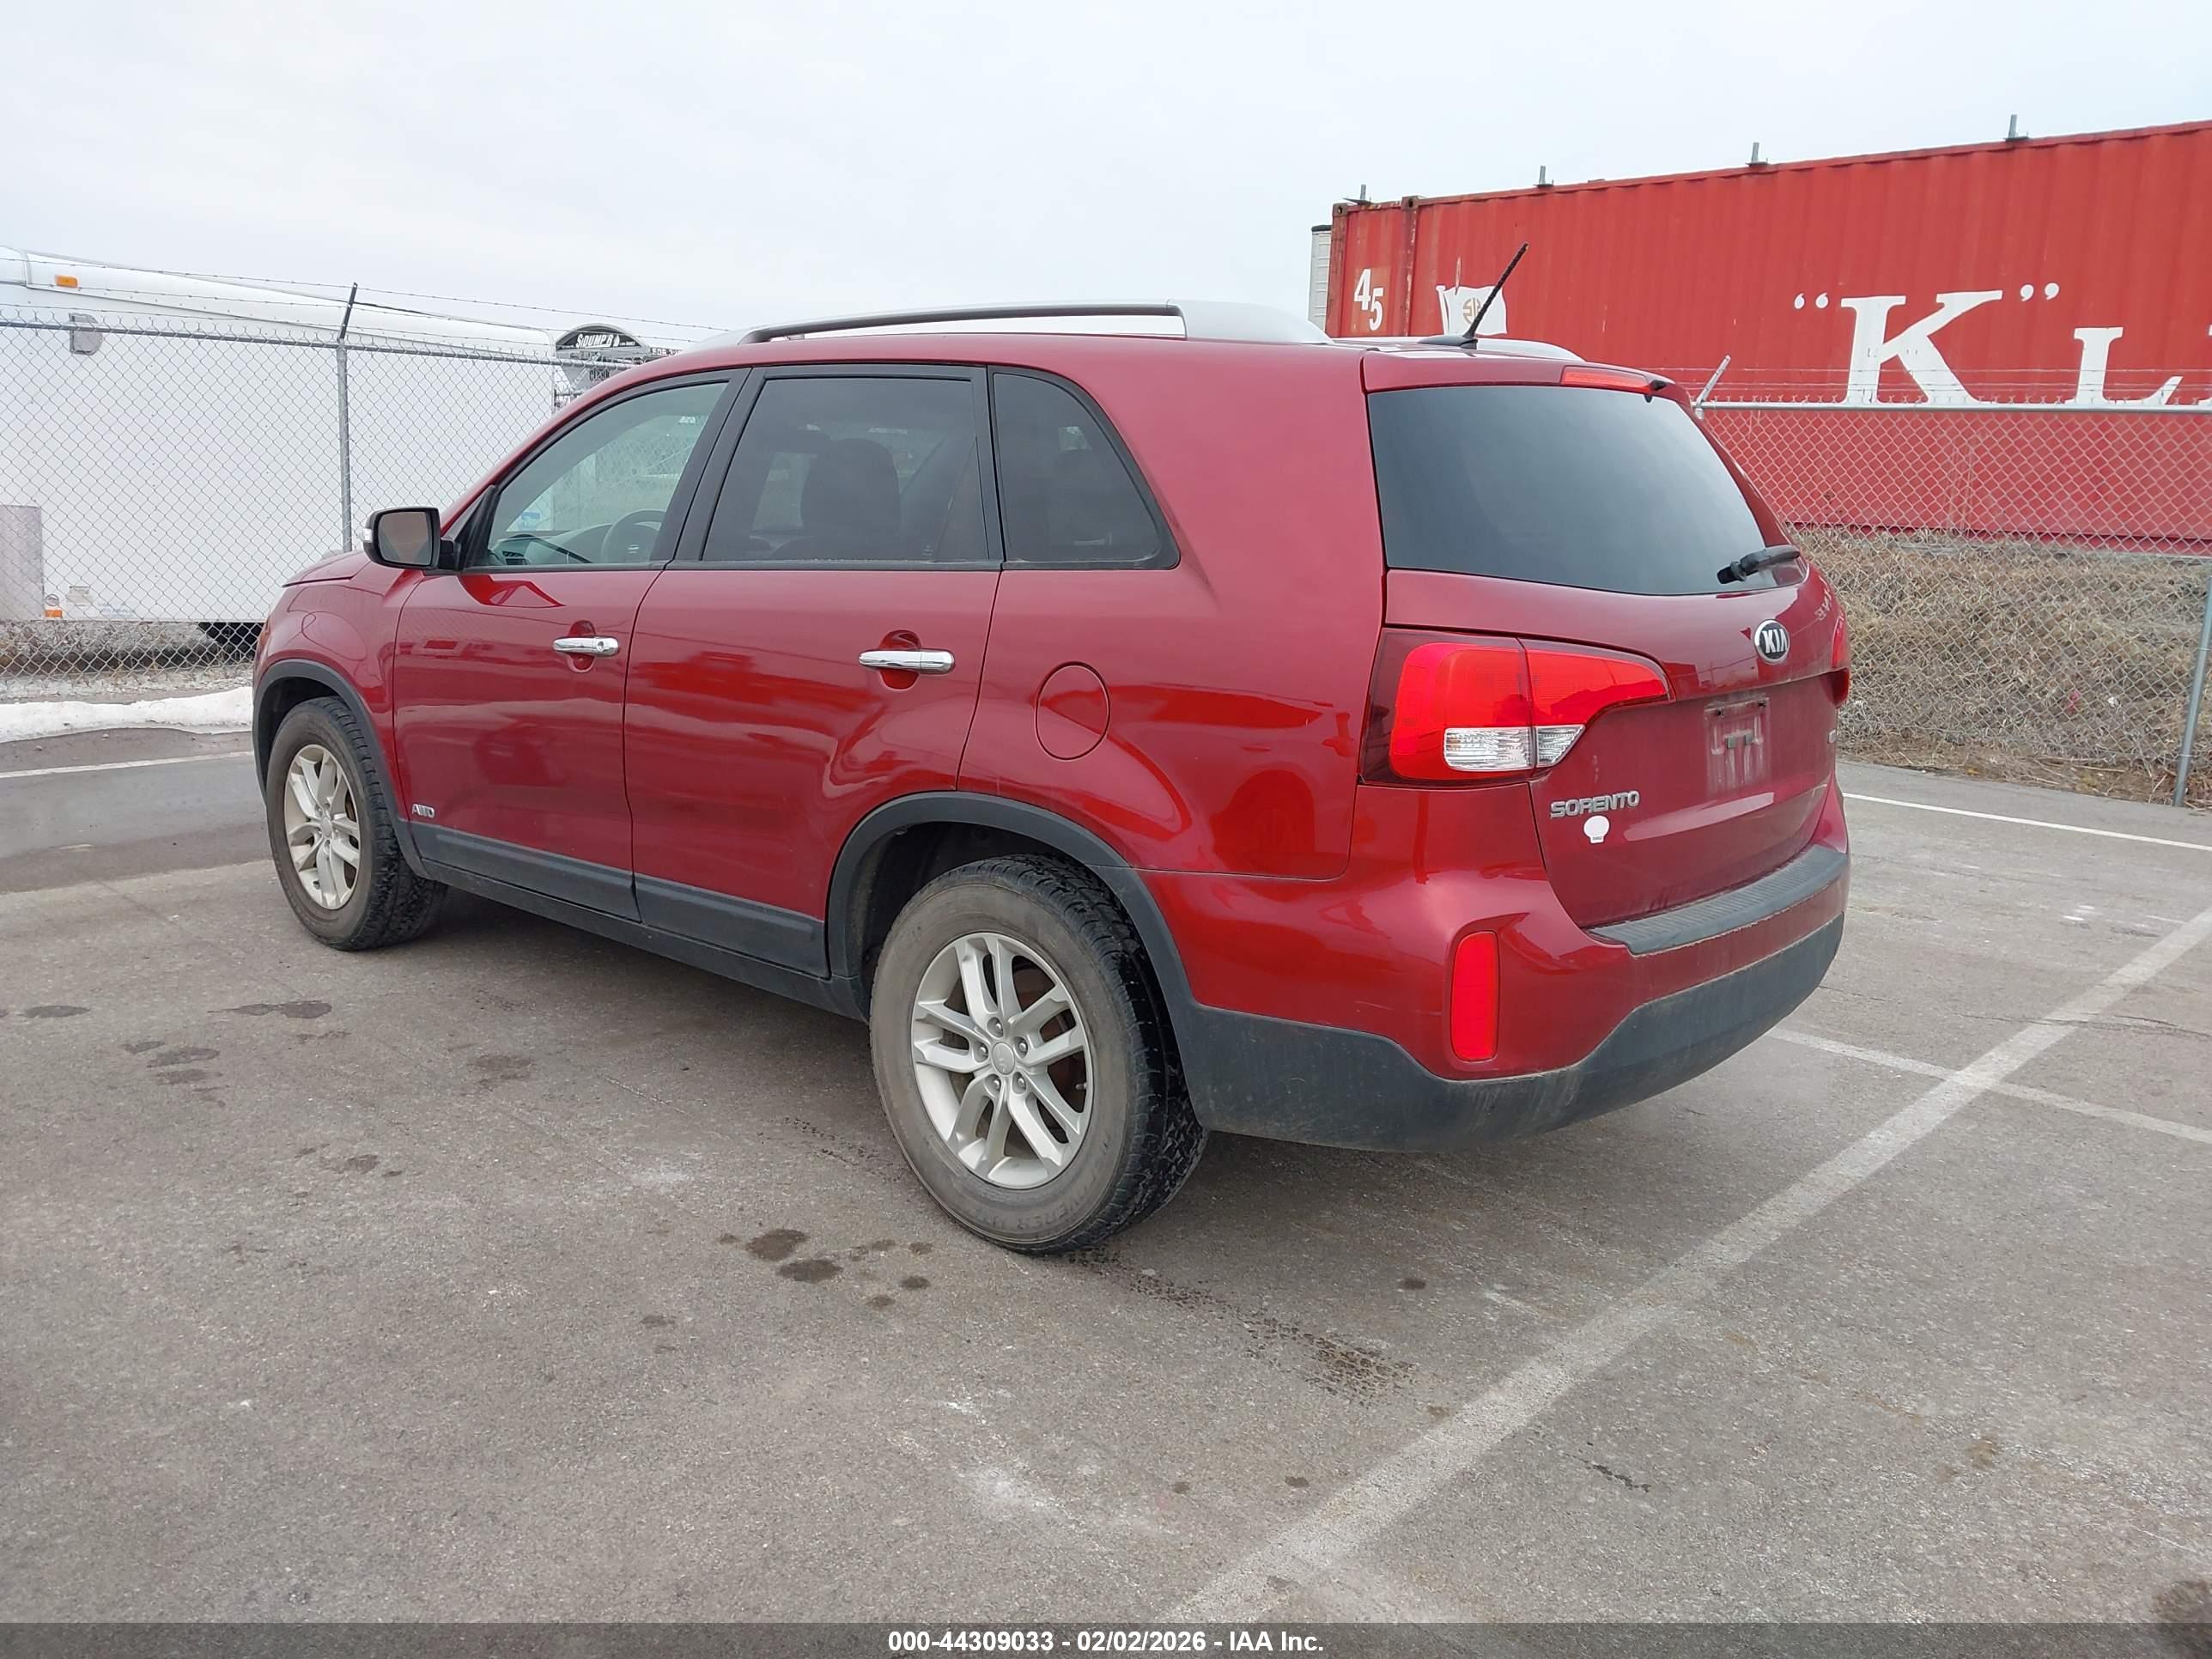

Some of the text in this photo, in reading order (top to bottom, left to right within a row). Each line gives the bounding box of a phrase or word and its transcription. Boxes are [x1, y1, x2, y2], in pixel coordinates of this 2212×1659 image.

[1353, 268, 1384, 331] 45
[1761, 628, 1789, 654] KIA
[1550, 790, 1640, 819] SORENTO
